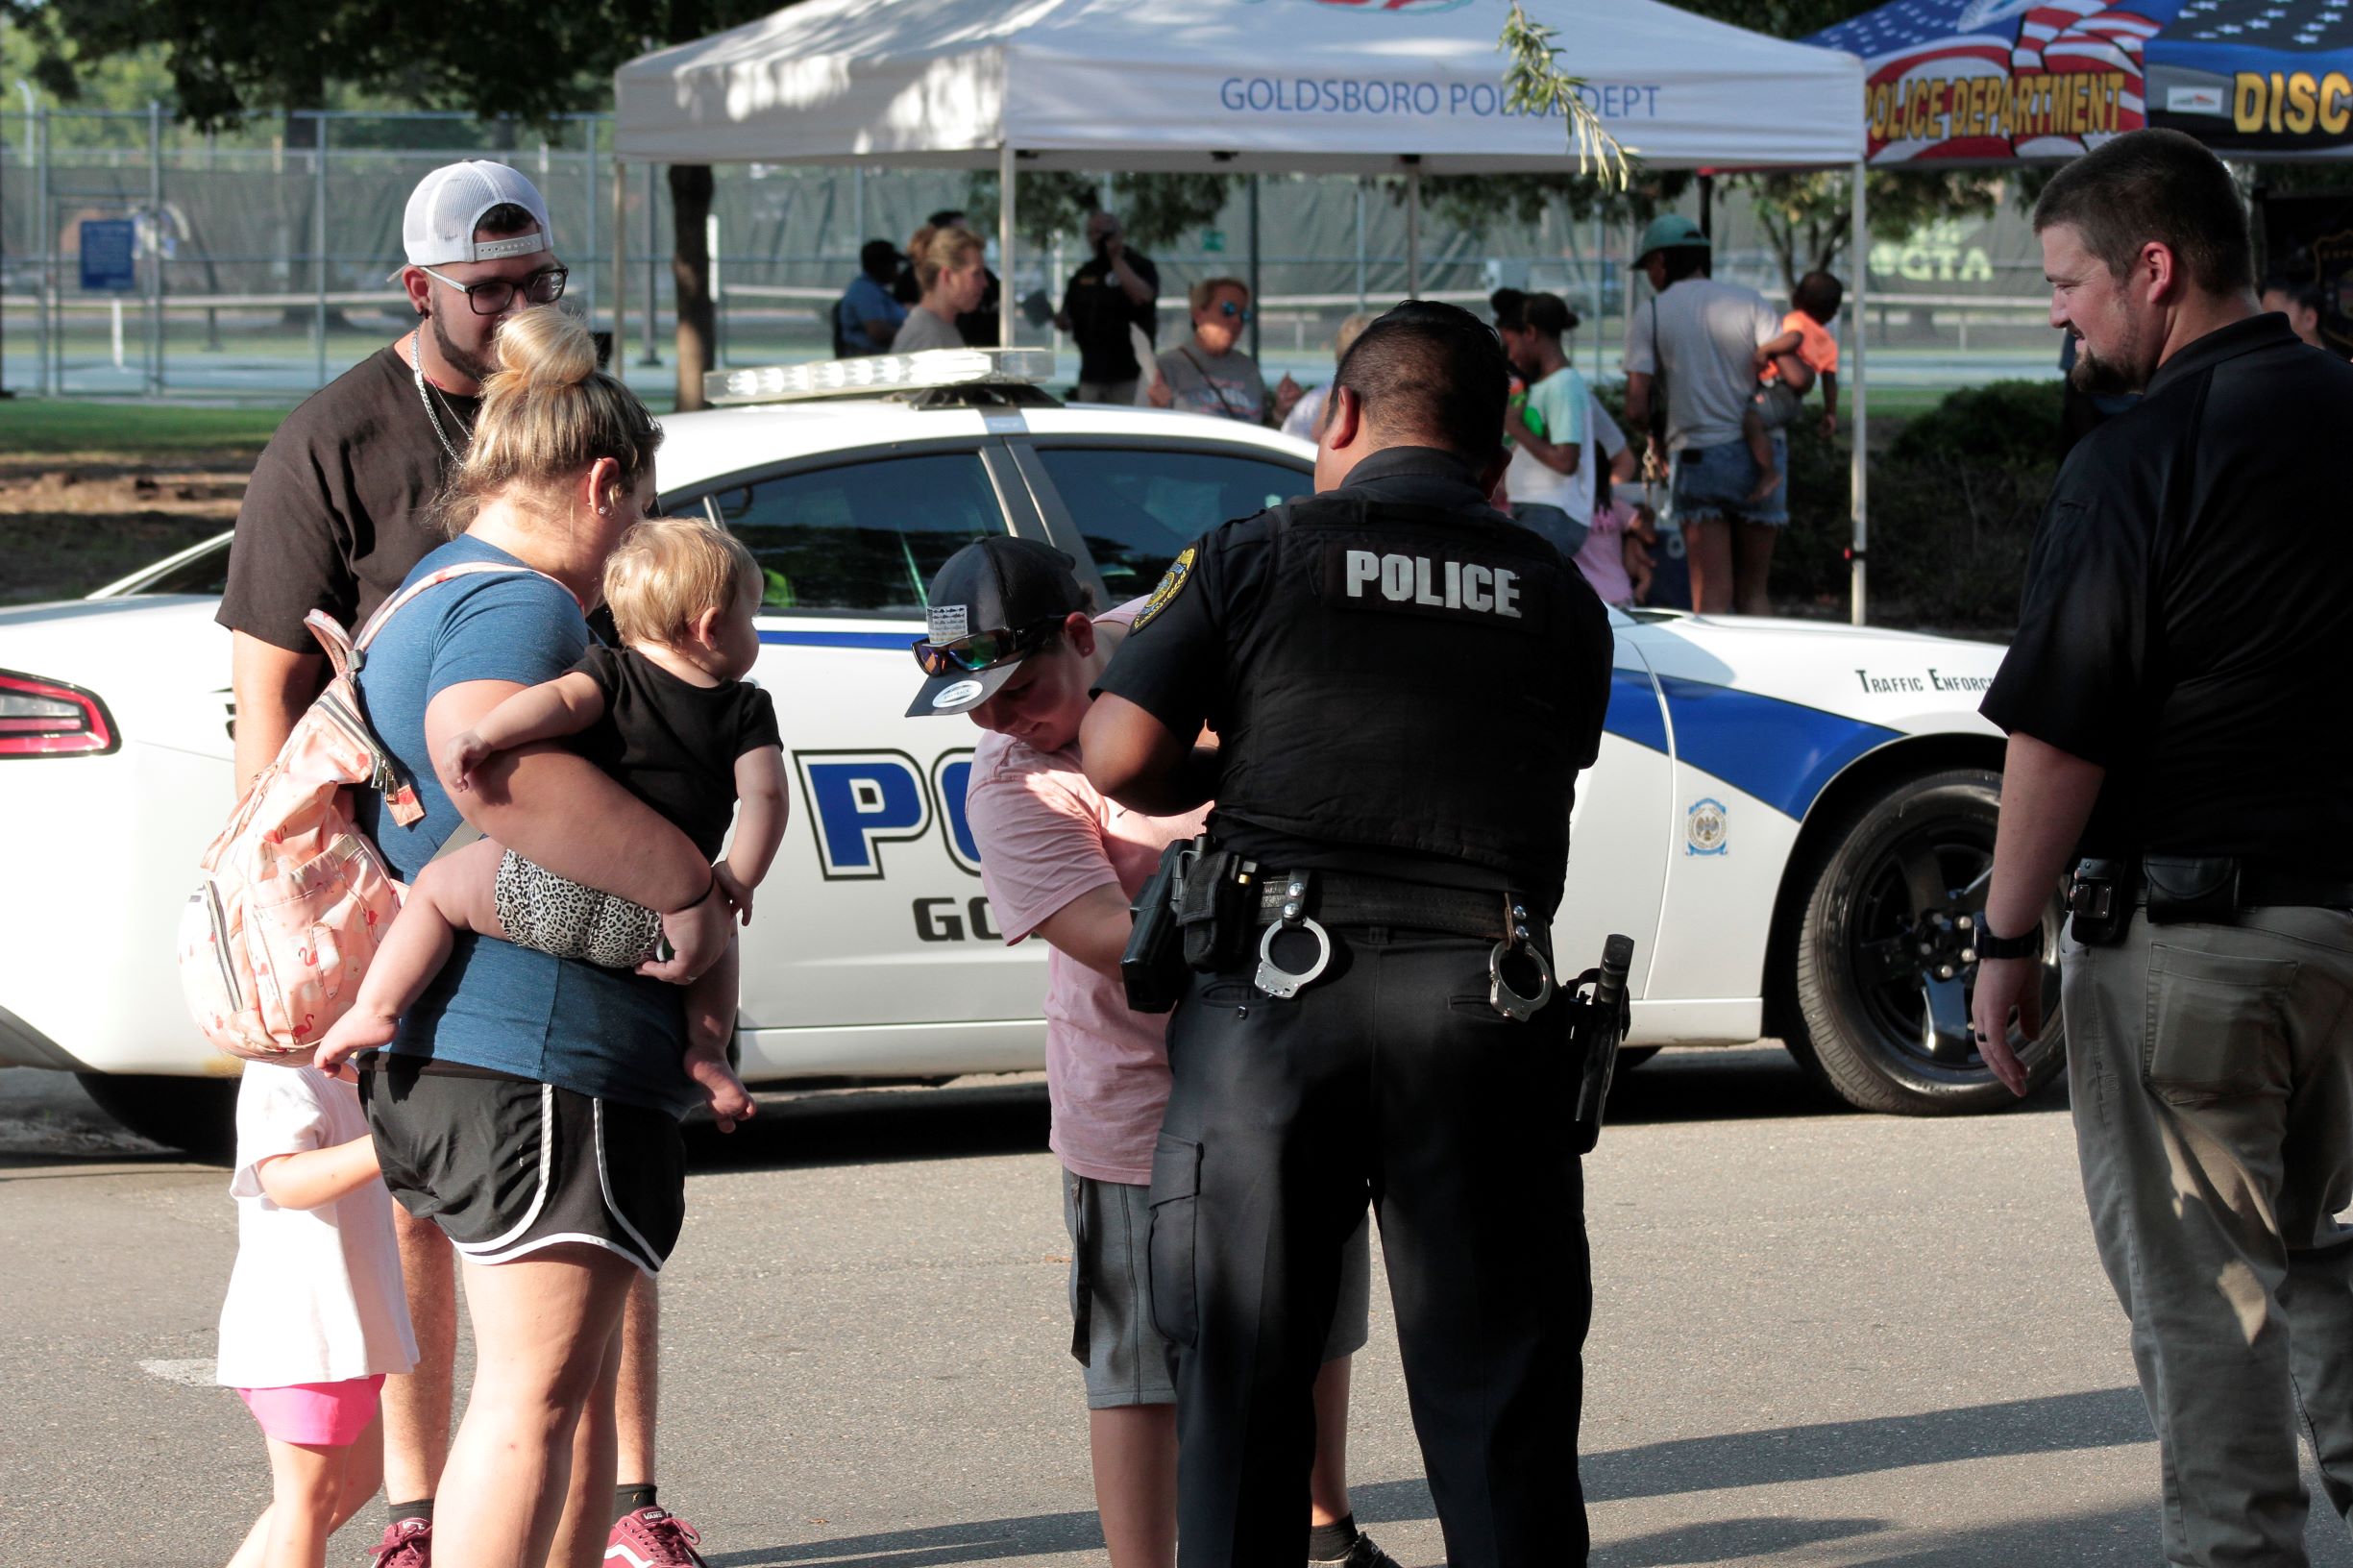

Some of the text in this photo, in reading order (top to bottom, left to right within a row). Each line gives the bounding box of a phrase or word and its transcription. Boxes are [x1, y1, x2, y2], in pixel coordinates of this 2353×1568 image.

[1220, 77, 1660, 117] GOLDSBORO POL DEPT
[1949, 72, 2124, 138] DEPARTMENT
[2233, 70, 2353, 135] DISC
[1346, 550, 1523, 619] POLICE
[643, 1510, 663, 1520] VANS
